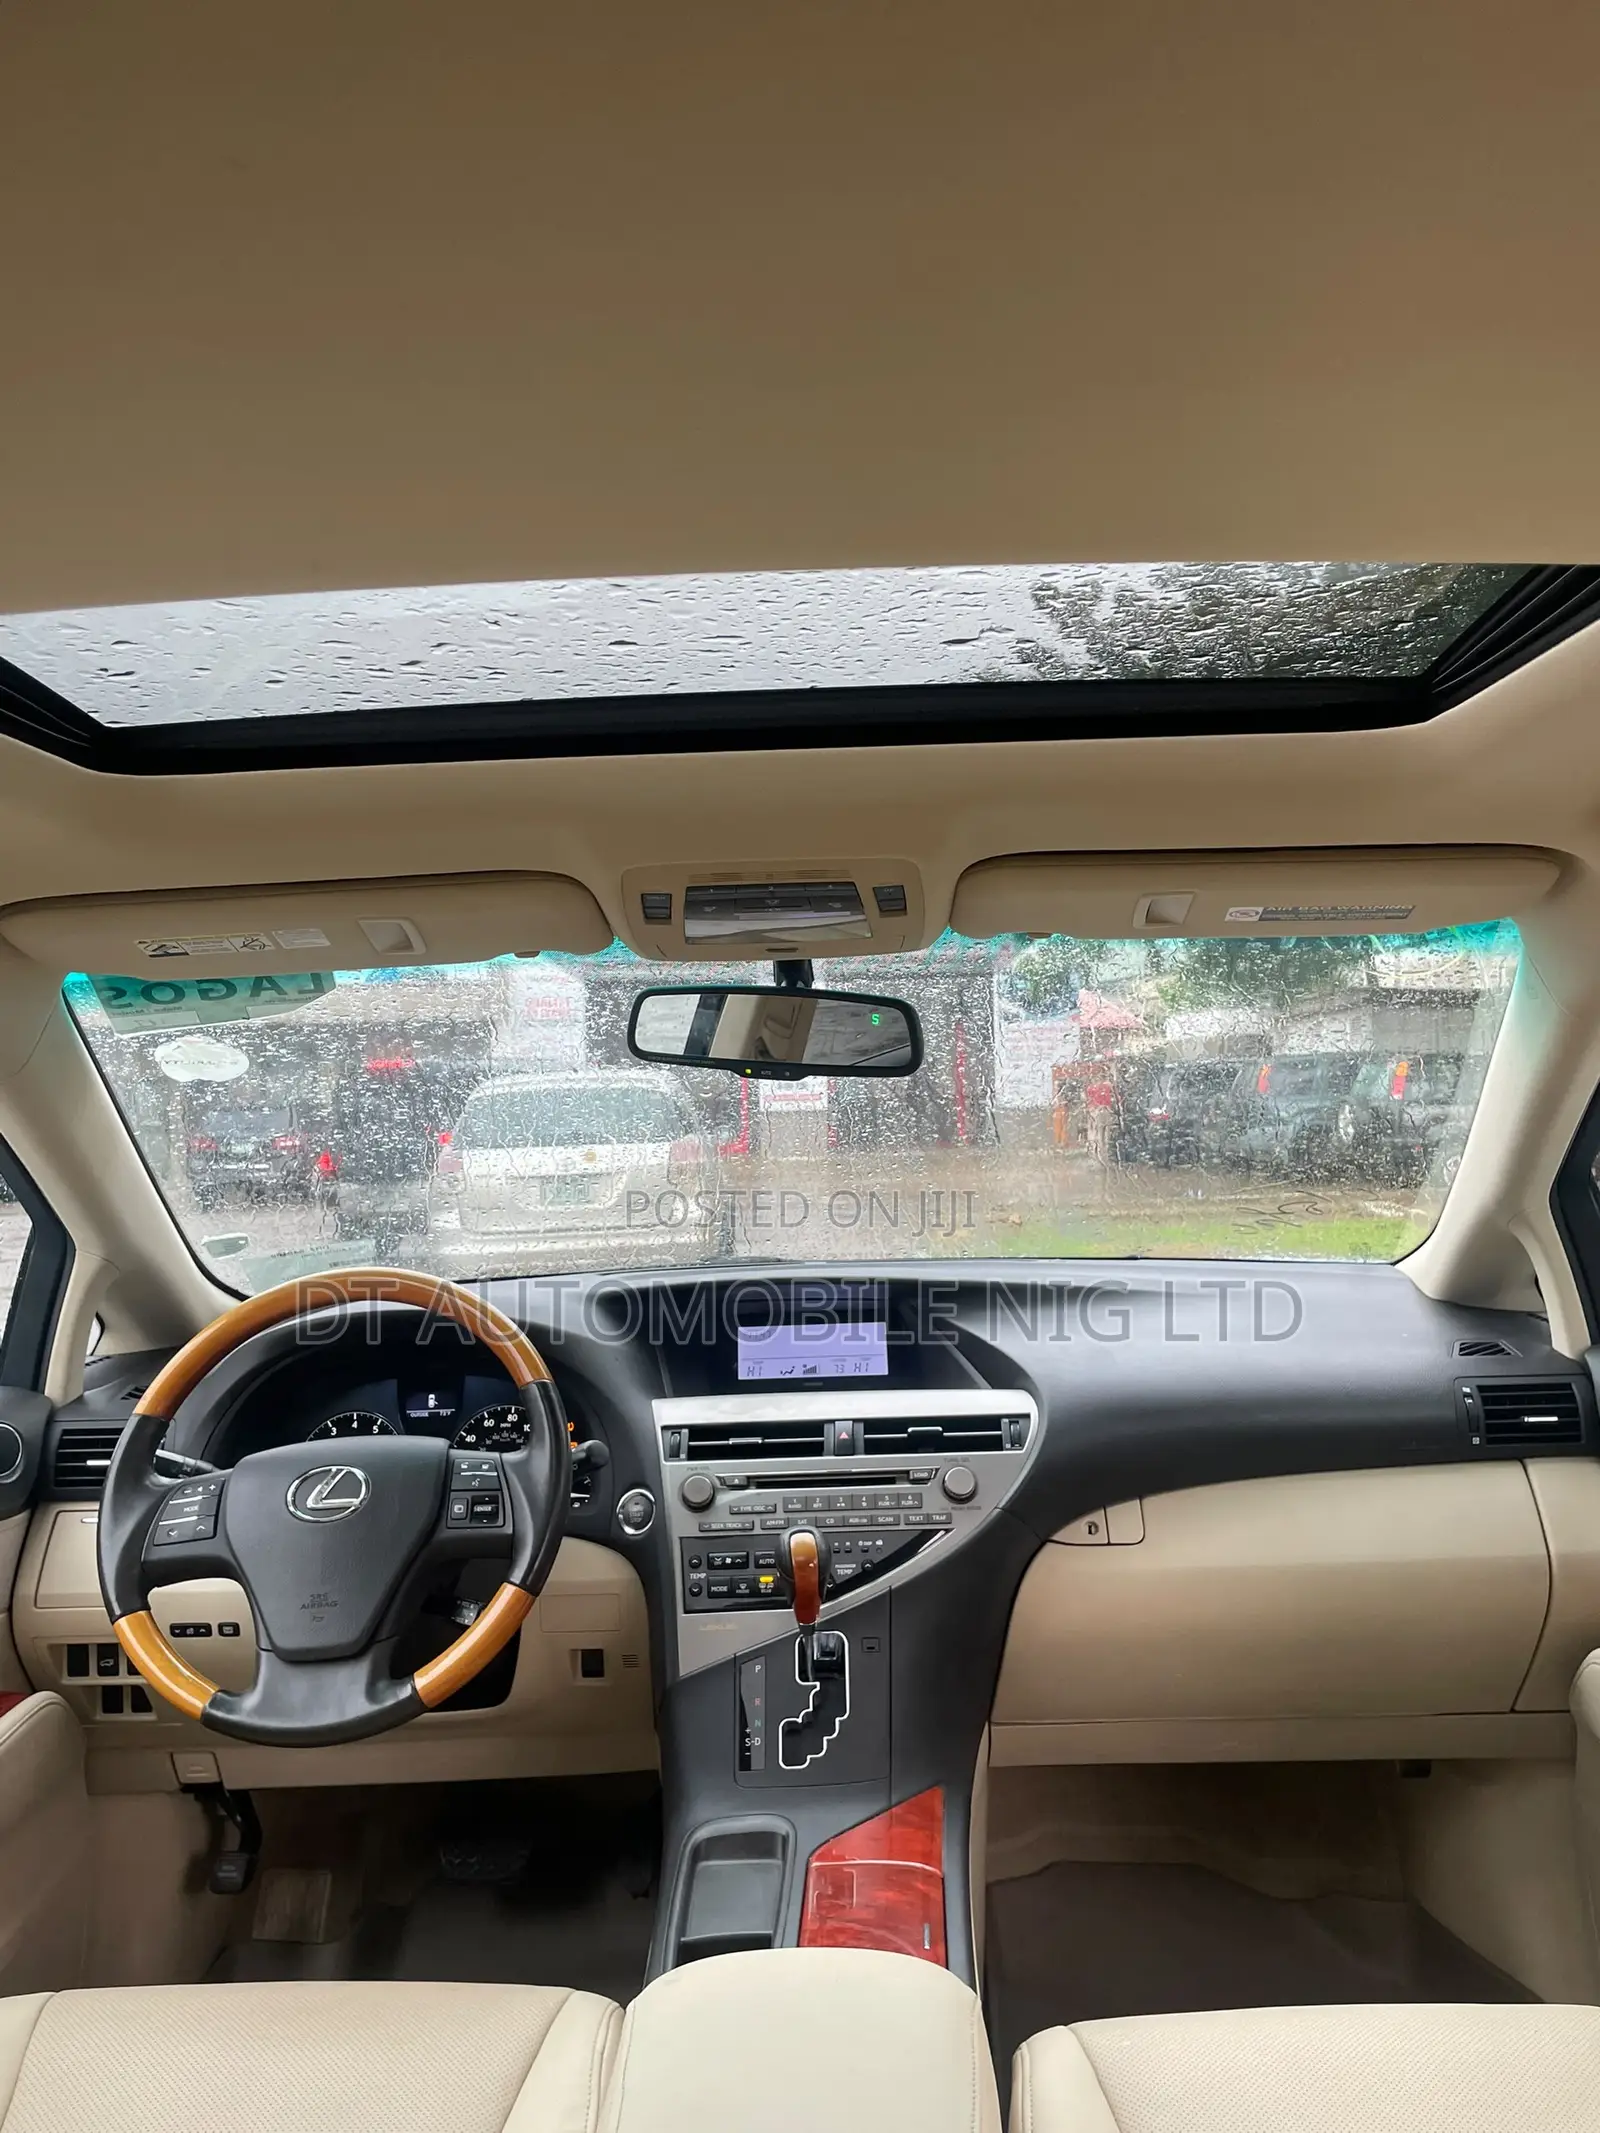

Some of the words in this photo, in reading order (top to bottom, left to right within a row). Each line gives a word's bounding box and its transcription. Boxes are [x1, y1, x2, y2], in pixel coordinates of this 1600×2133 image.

[871, 1013, 880, 1025] S
[507, 1413, 518, 1422] 80
[351, 1420, 358, 1429] 4
[483, 1419, 495, 1427] 60
[330, 1427, 337, 1436] 3
[372, 1425, 379, 1434] 5
[465, 1434, 476, 1443] 40
[755, 1664, 762, 1673] P
[754, 1697, 761, 1706] R
[754, 1719, 761, 1727] N
